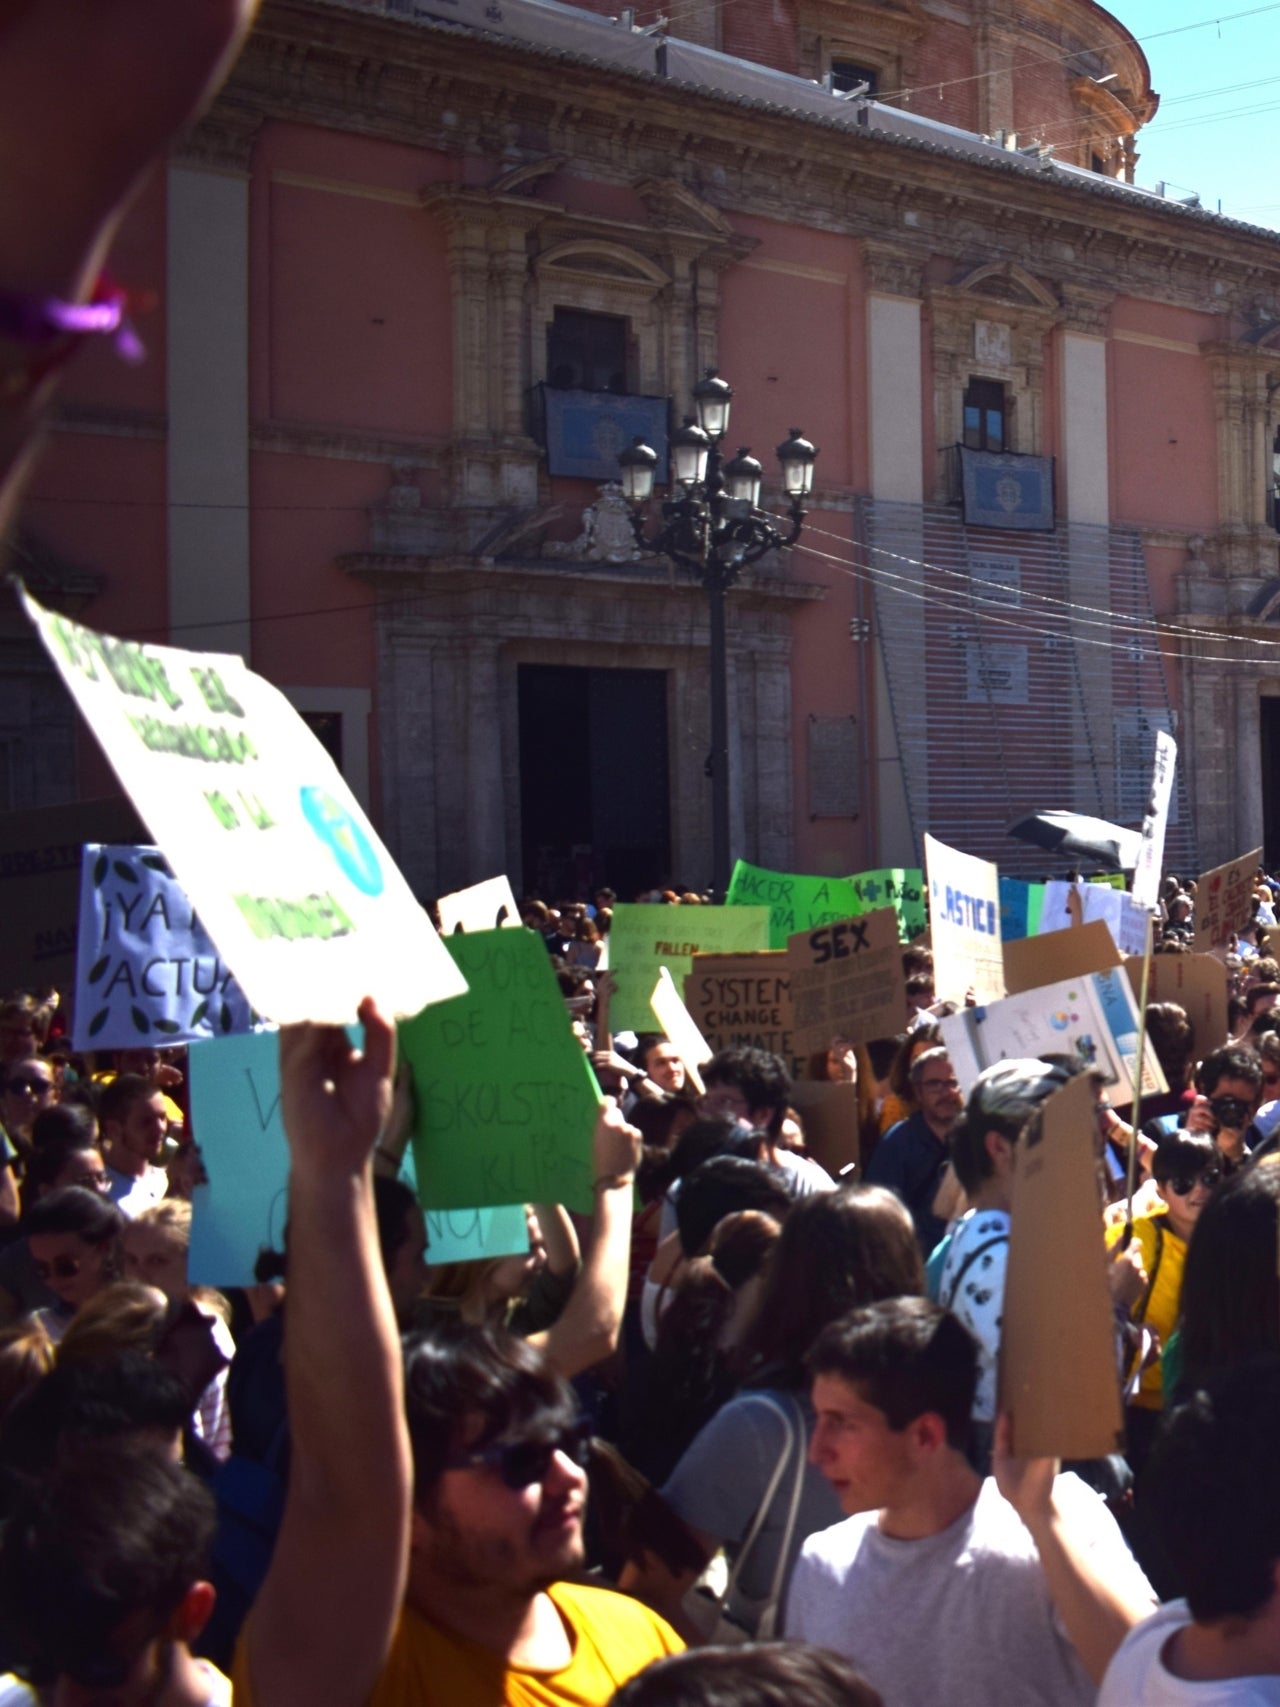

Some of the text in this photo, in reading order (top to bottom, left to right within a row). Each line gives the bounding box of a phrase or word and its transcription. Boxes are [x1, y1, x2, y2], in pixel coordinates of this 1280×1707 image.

[812, 882, 831, 905] A
[932, 880, 996, 937] ASTICO
[654, 940, 701, 957] FALLEN
[809, 920, 871, 965] SEX
[700, 976, 794, 1009] SYSTEM
[703, 1007, 783, 1029] CHANGE
